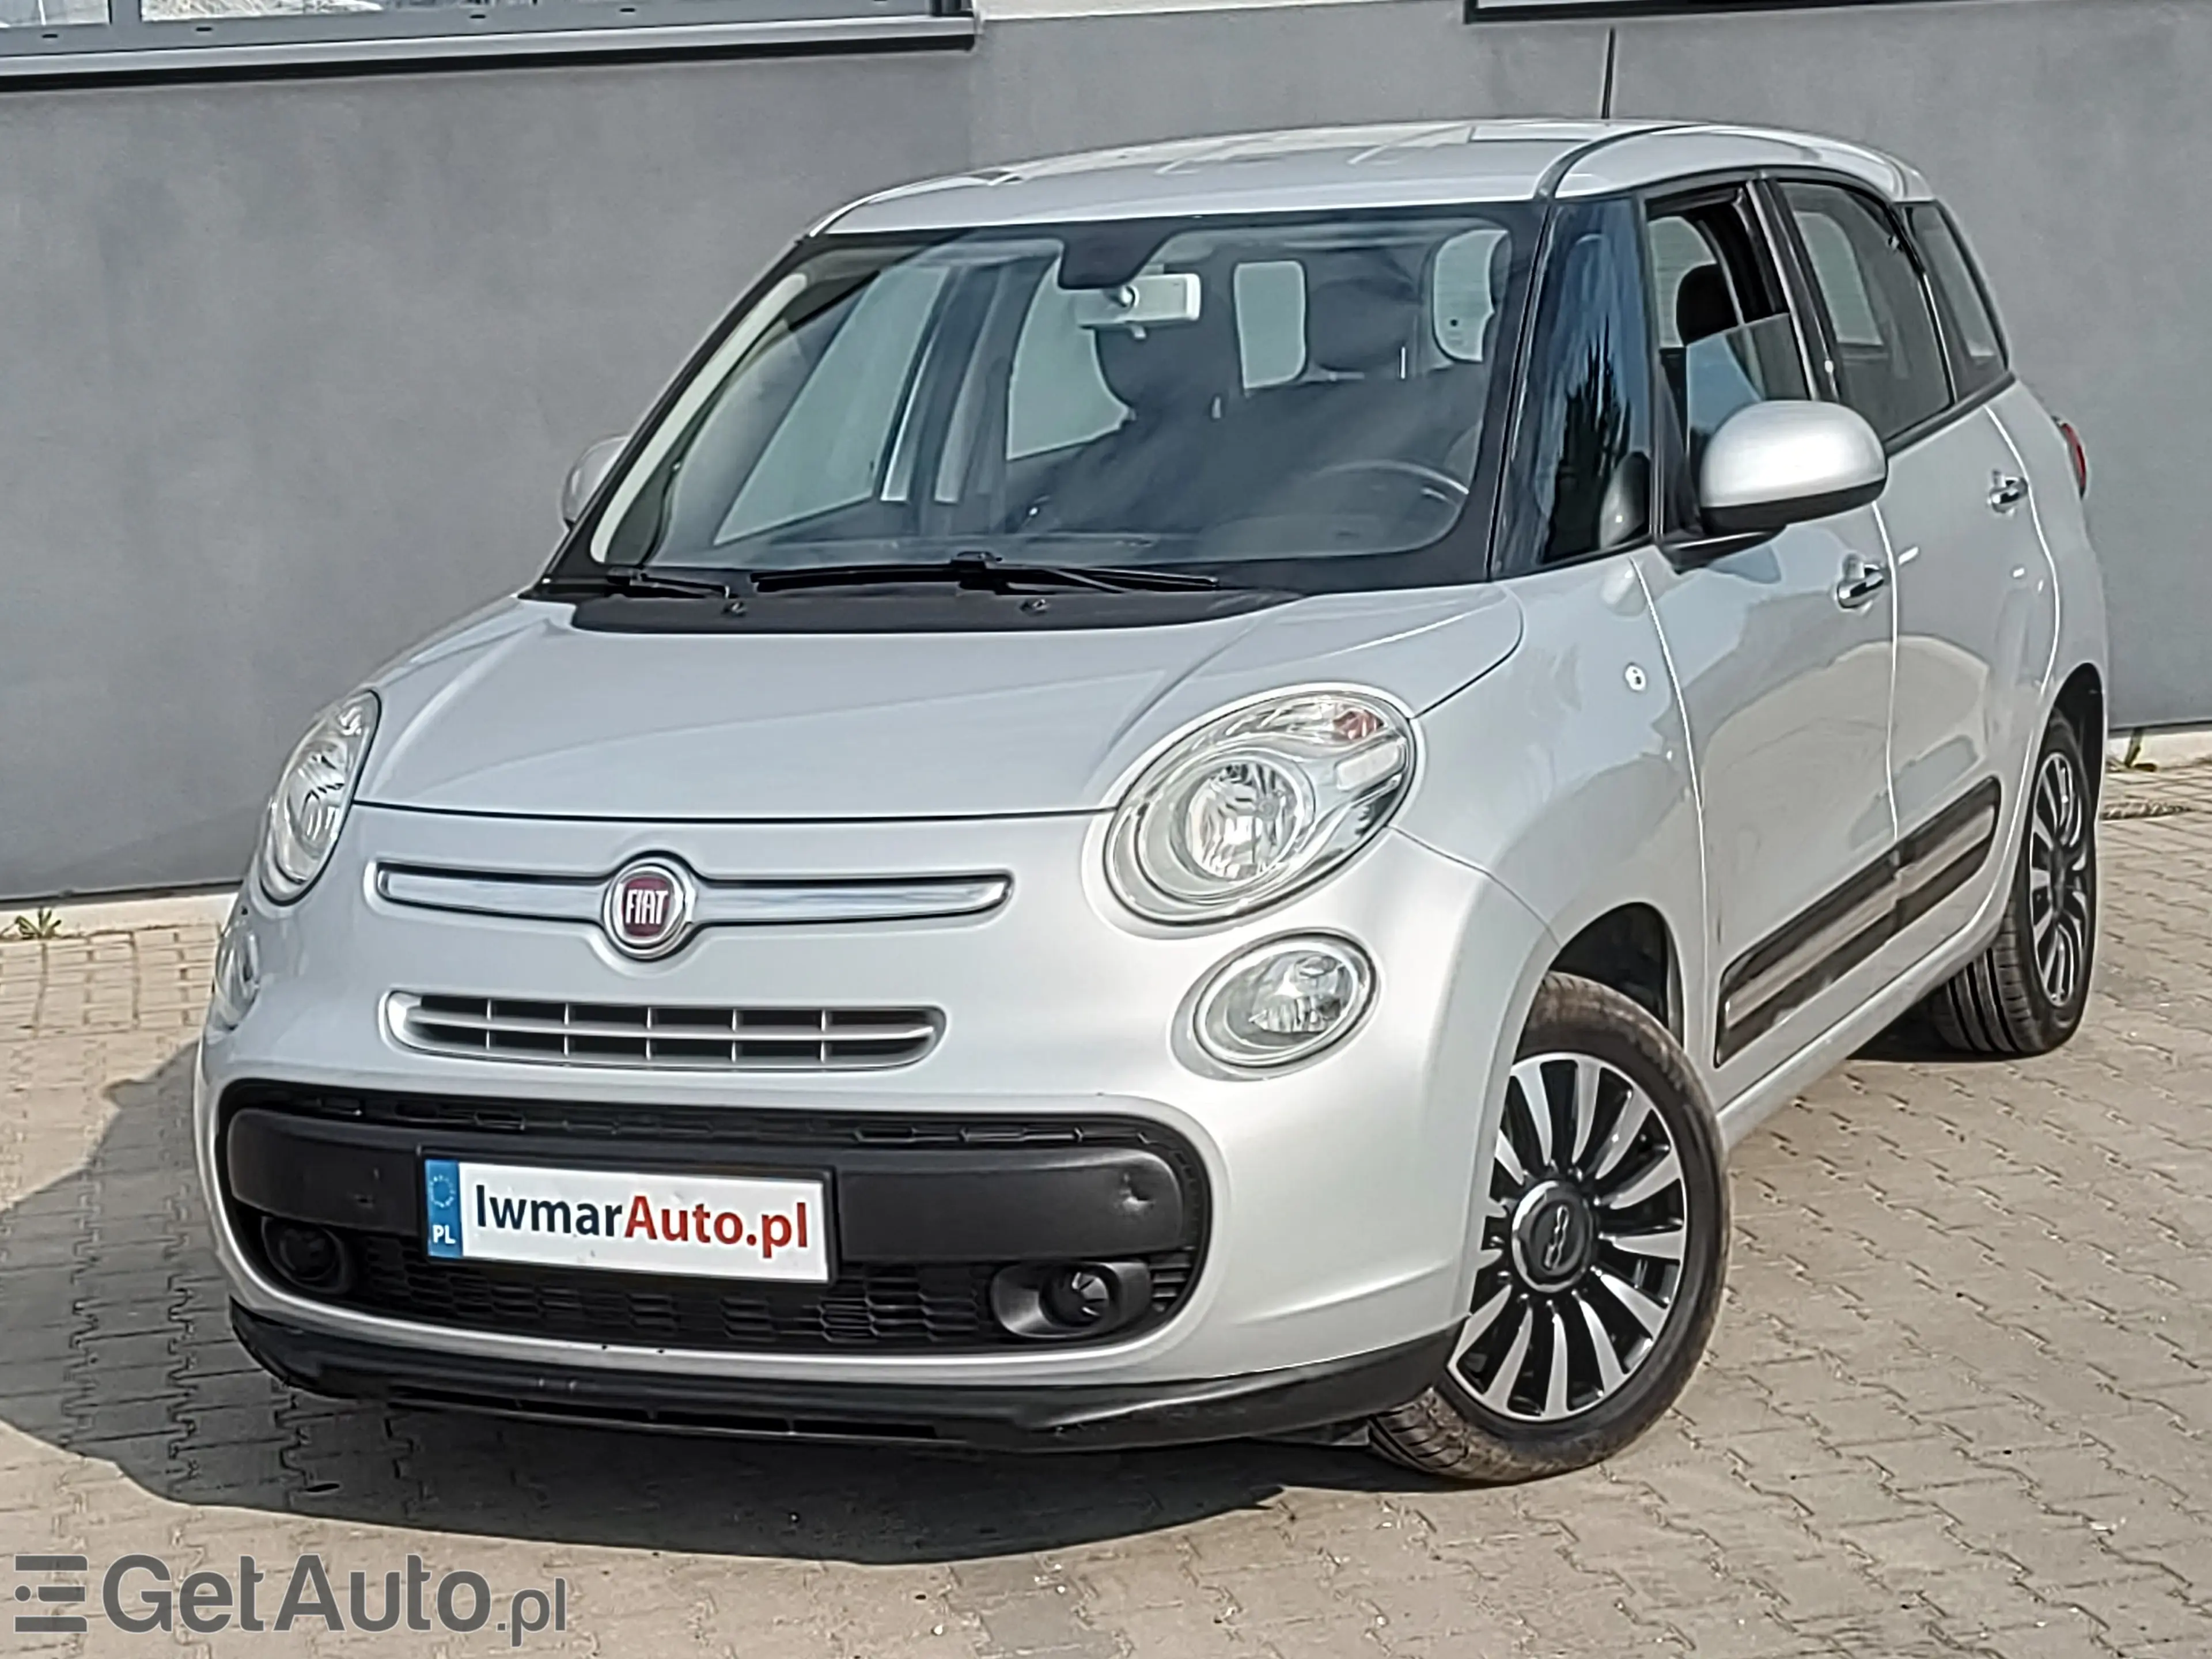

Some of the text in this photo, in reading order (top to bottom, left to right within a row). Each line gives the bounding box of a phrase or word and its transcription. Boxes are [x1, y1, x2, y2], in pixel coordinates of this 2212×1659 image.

[626, 889, 668, 924] FIAT
[433, 1225, 456, 1245] PL
[476, 1184, 808, 1258] IwmarAuto.pl
